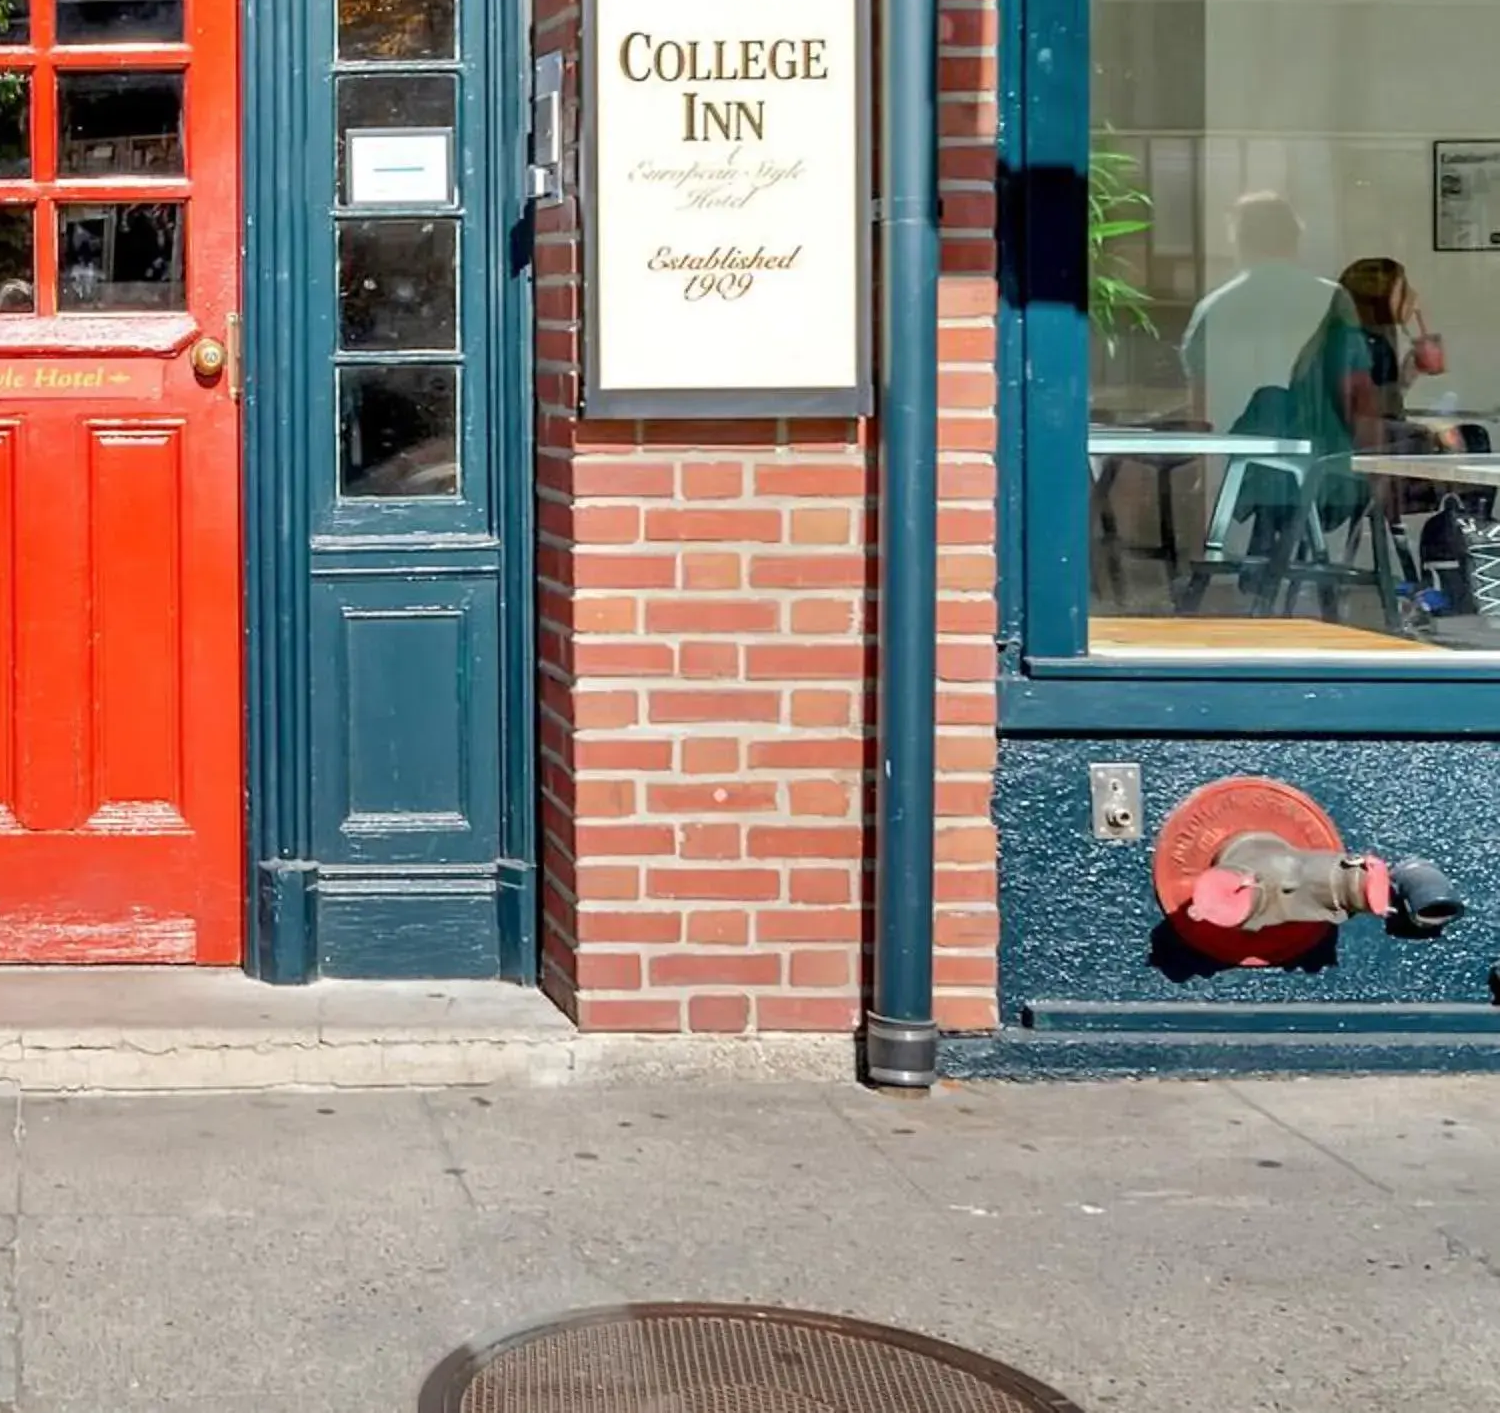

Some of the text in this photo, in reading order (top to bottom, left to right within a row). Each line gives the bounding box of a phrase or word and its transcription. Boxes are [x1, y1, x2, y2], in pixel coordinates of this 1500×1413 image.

[619, 32, 829, 82] COLLEGE
[682, 92, 766, 143] INN
[647, 243, 803, 272] Established
[682, 272, 755, 302] 1909
[34, 366, 105, 388] Hotel
